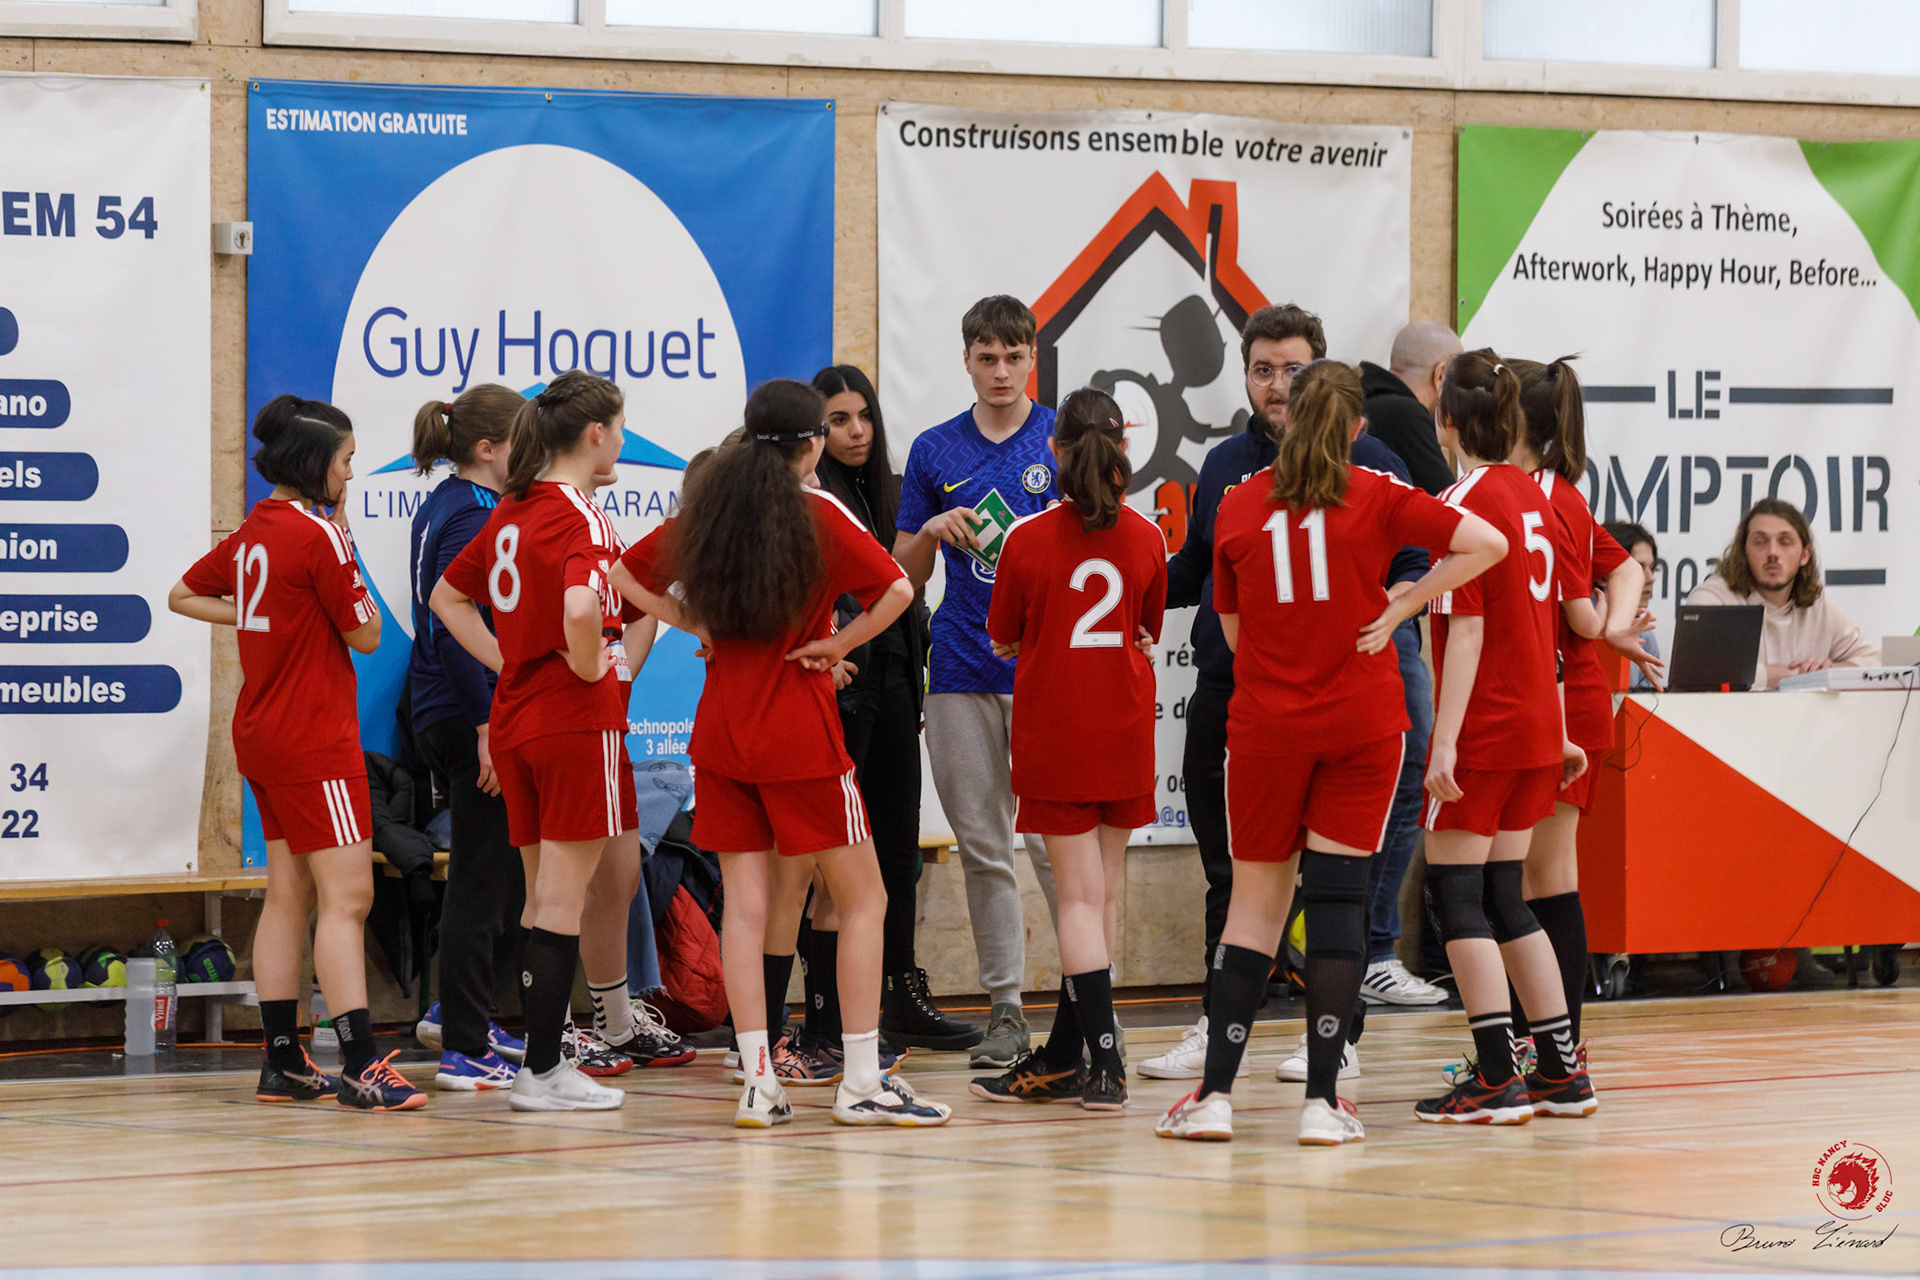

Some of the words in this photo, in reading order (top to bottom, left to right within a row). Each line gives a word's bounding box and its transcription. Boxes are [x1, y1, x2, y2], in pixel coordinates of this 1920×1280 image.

[266, 108, 376, 133] ESTIMATION
[378, 112, 468, 136] GRATUITE
[899, 119, 1080, 151] Construisons
[1088, 128, 1224, 157] ensemble
[1235, 137, 1303, 163] votre
[1310, 142, 1388, 168] avenir
[95, 195, 158, 240] 54
[1602, 201, 1684, 230] Soirées
[1690, 203, 1704, 230] à
[1711, 203, 1798, 238] Thème,
[1512, 252, 1637, 288] Afterwork,
[1644, 256, 1713, 290] Happy
[1720, 257, 1782, 291] Hour,
[1789, 259, 1878, 288] Before...
[363, 306, 480, 394] Guy
[498, 309, 718, 384] Hoquet
[1667, 370, 1722, 420] LE
[1586, 454, 1891, 533] MPTOIR
[415, 521, 431, 605] 1
[488, 523, 521, 613] 8
[1261, 508, 1330, 604] 11
[1521, 511, 1555, 602] 5
[232, 541, 271, 633] 12
[1069, 558, 1123, 649] 2
[0, 603, 99, 639] eprise
[645, 738, 654, 755] 3
[656, 737, 688, 755] allée
[9, 762, 49, 792] 34
[1, 808, 40, 839] 22
